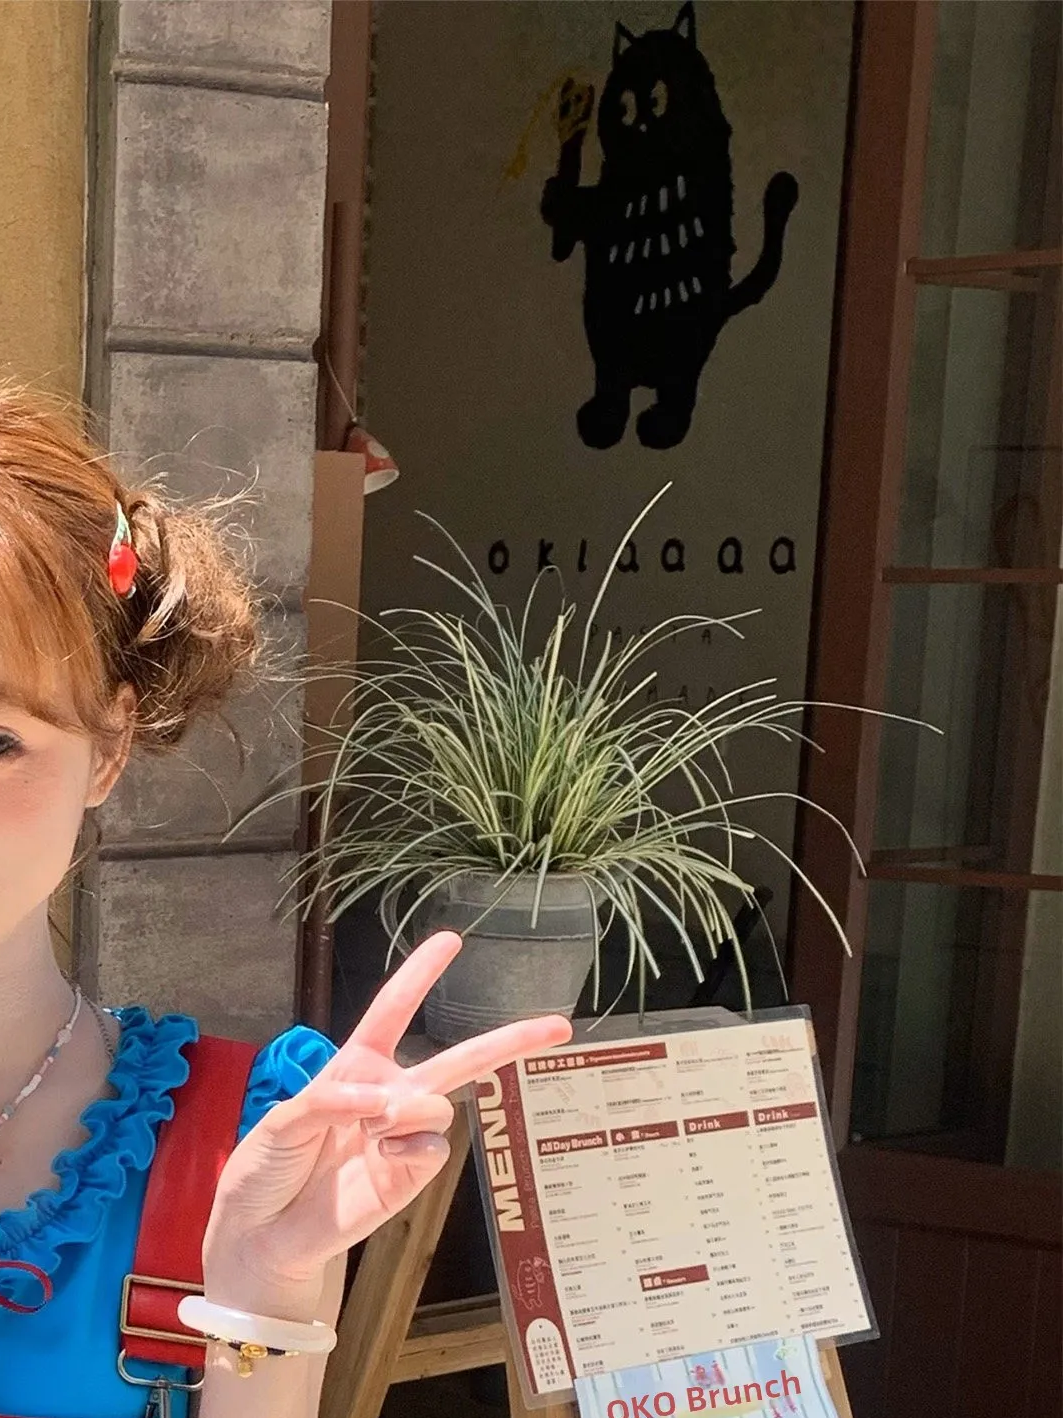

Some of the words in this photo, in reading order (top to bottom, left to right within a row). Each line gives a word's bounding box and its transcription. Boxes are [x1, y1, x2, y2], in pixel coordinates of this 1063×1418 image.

[688, 1118, 722, 1132] Drink
[757, 1109, 790, 1123] Drink
[477, 1071, 525, 1231] MENU
[686, 1369, 802, 1412] Brunch
